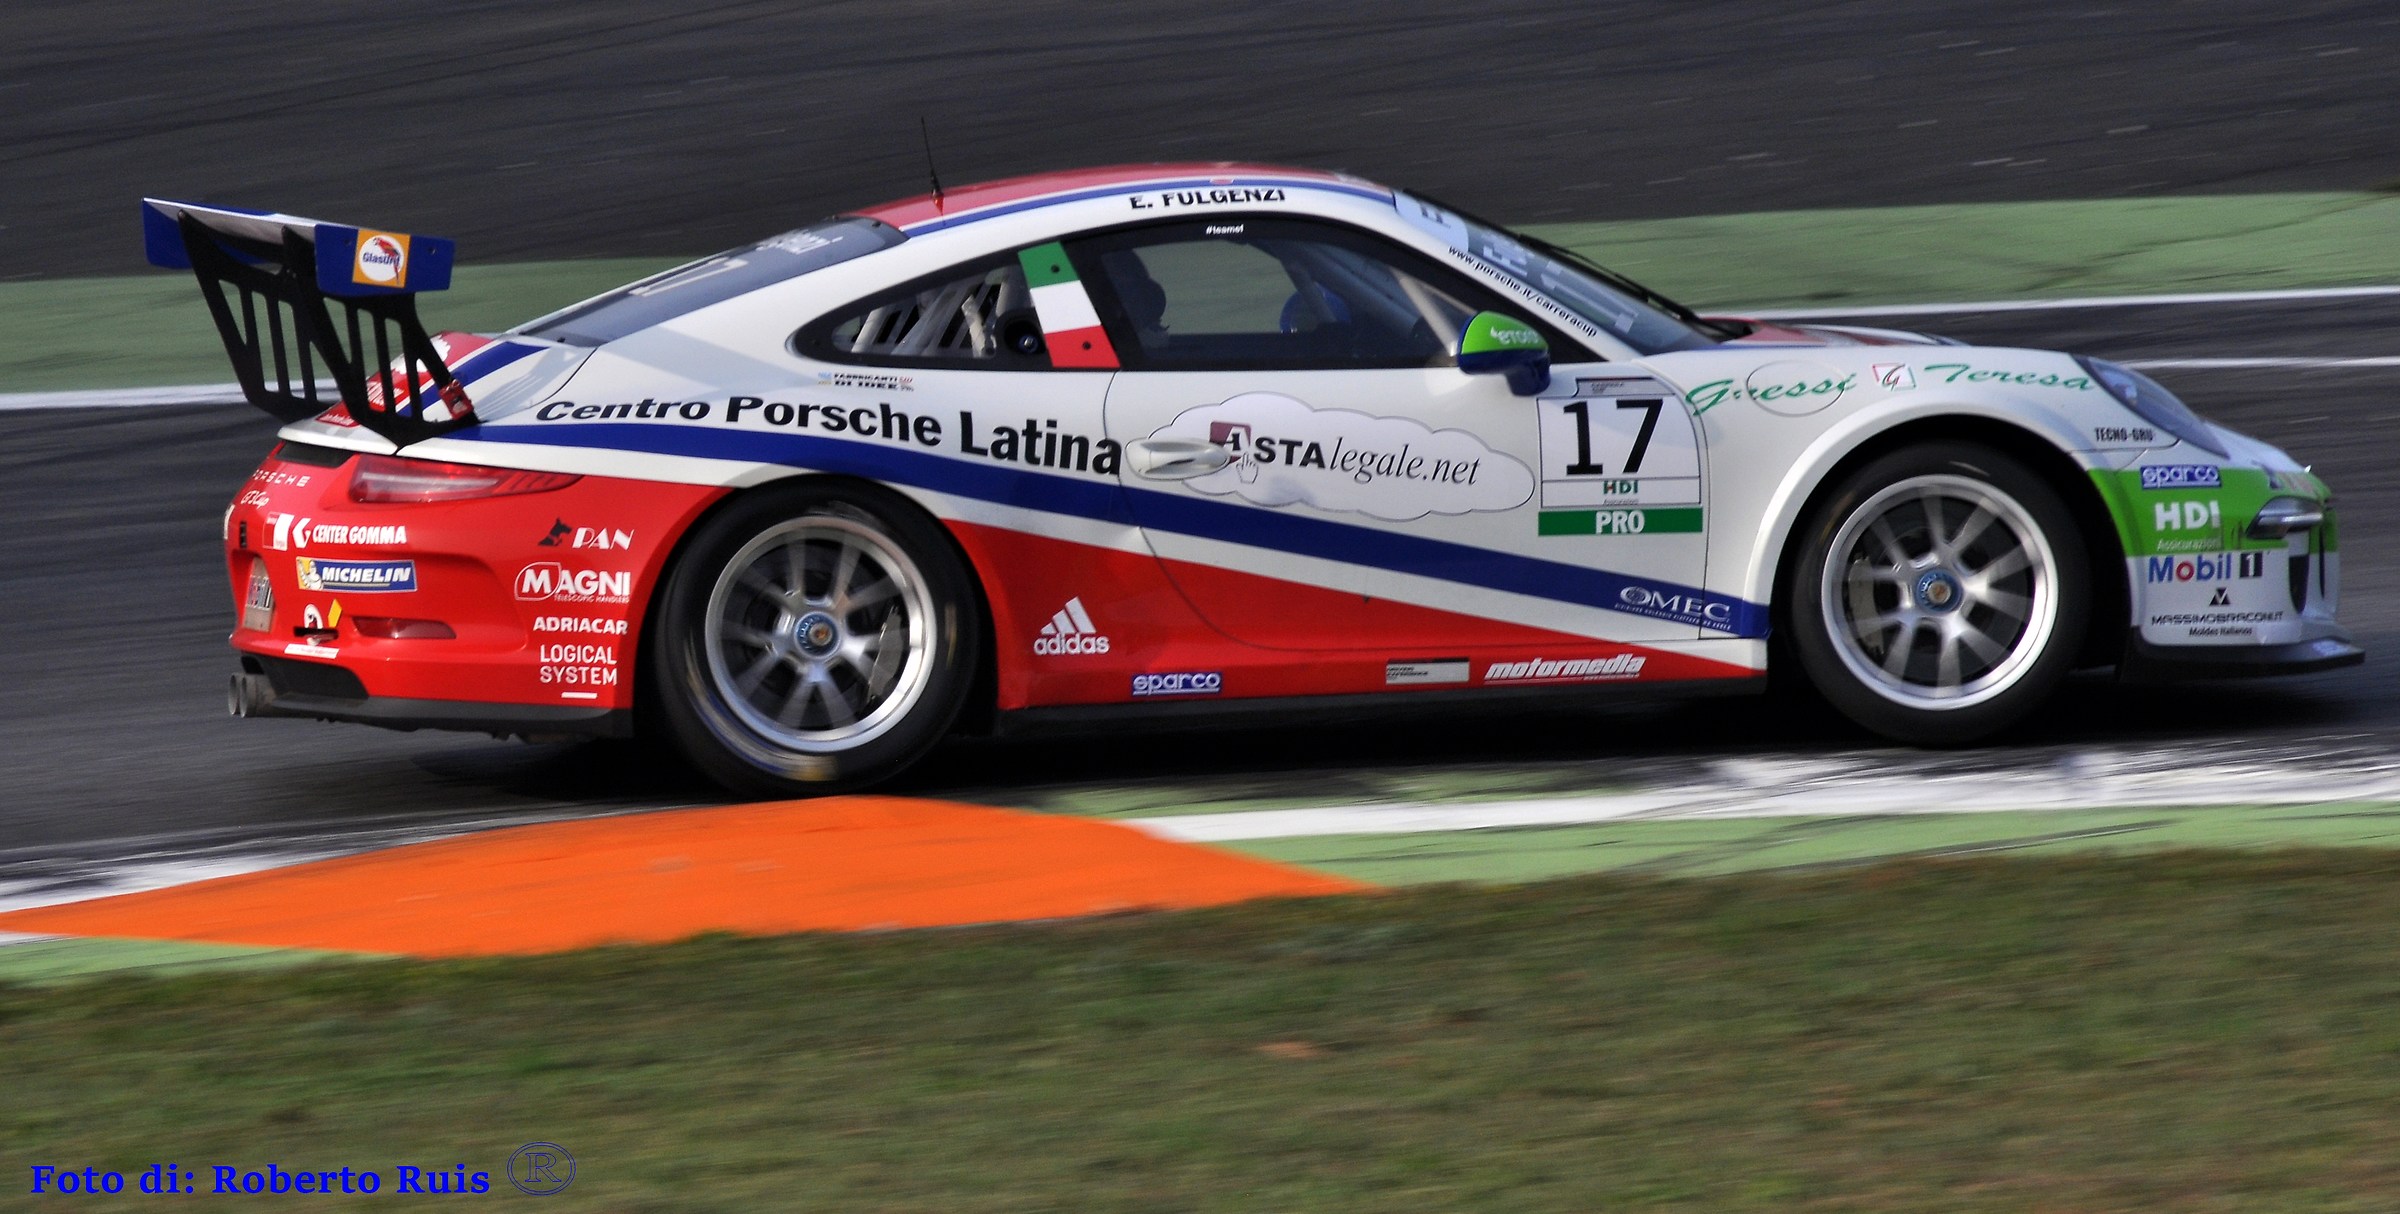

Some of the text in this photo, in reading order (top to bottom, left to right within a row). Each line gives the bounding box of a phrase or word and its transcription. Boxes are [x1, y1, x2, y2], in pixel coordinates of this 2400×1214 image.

[1130, 189, 1286, 209] E. FULGENZI
[1924, 363, 2095, 390] Teresa
[536, 396, 1122, 476] Centro Porsche Latina
[1563, 398, 1664, 476] 17
[1603, 480, 1638, 494] HDI
[2142, 466, 2220, 487] sparco
[1595, 510, 1646, 534] PRO
[2154, 500, 2220, 531] HDI
[312, 524, 349, 544] CENTER
[349, 525, 407, 545] GOMMA
[572, 527, 635, 550] PAN
[321, 567, 411, 583] MICHELIN
[2148, 552, 2231, 584] Mobil
[521, 568, 631, 597] MAGNI
[1620, 586, 1731, 623] OMEC
[533, 617, 629, 635] ADRIACAR
[540, 644, 618, 665] LOGICAL
[1033, 633, 1110, 655] adidas
[540, 665, 618, 686] SYSTEM
[1484, 653, 1647, 681] motormedia
[1133, 673, 1221, 695] sparco
